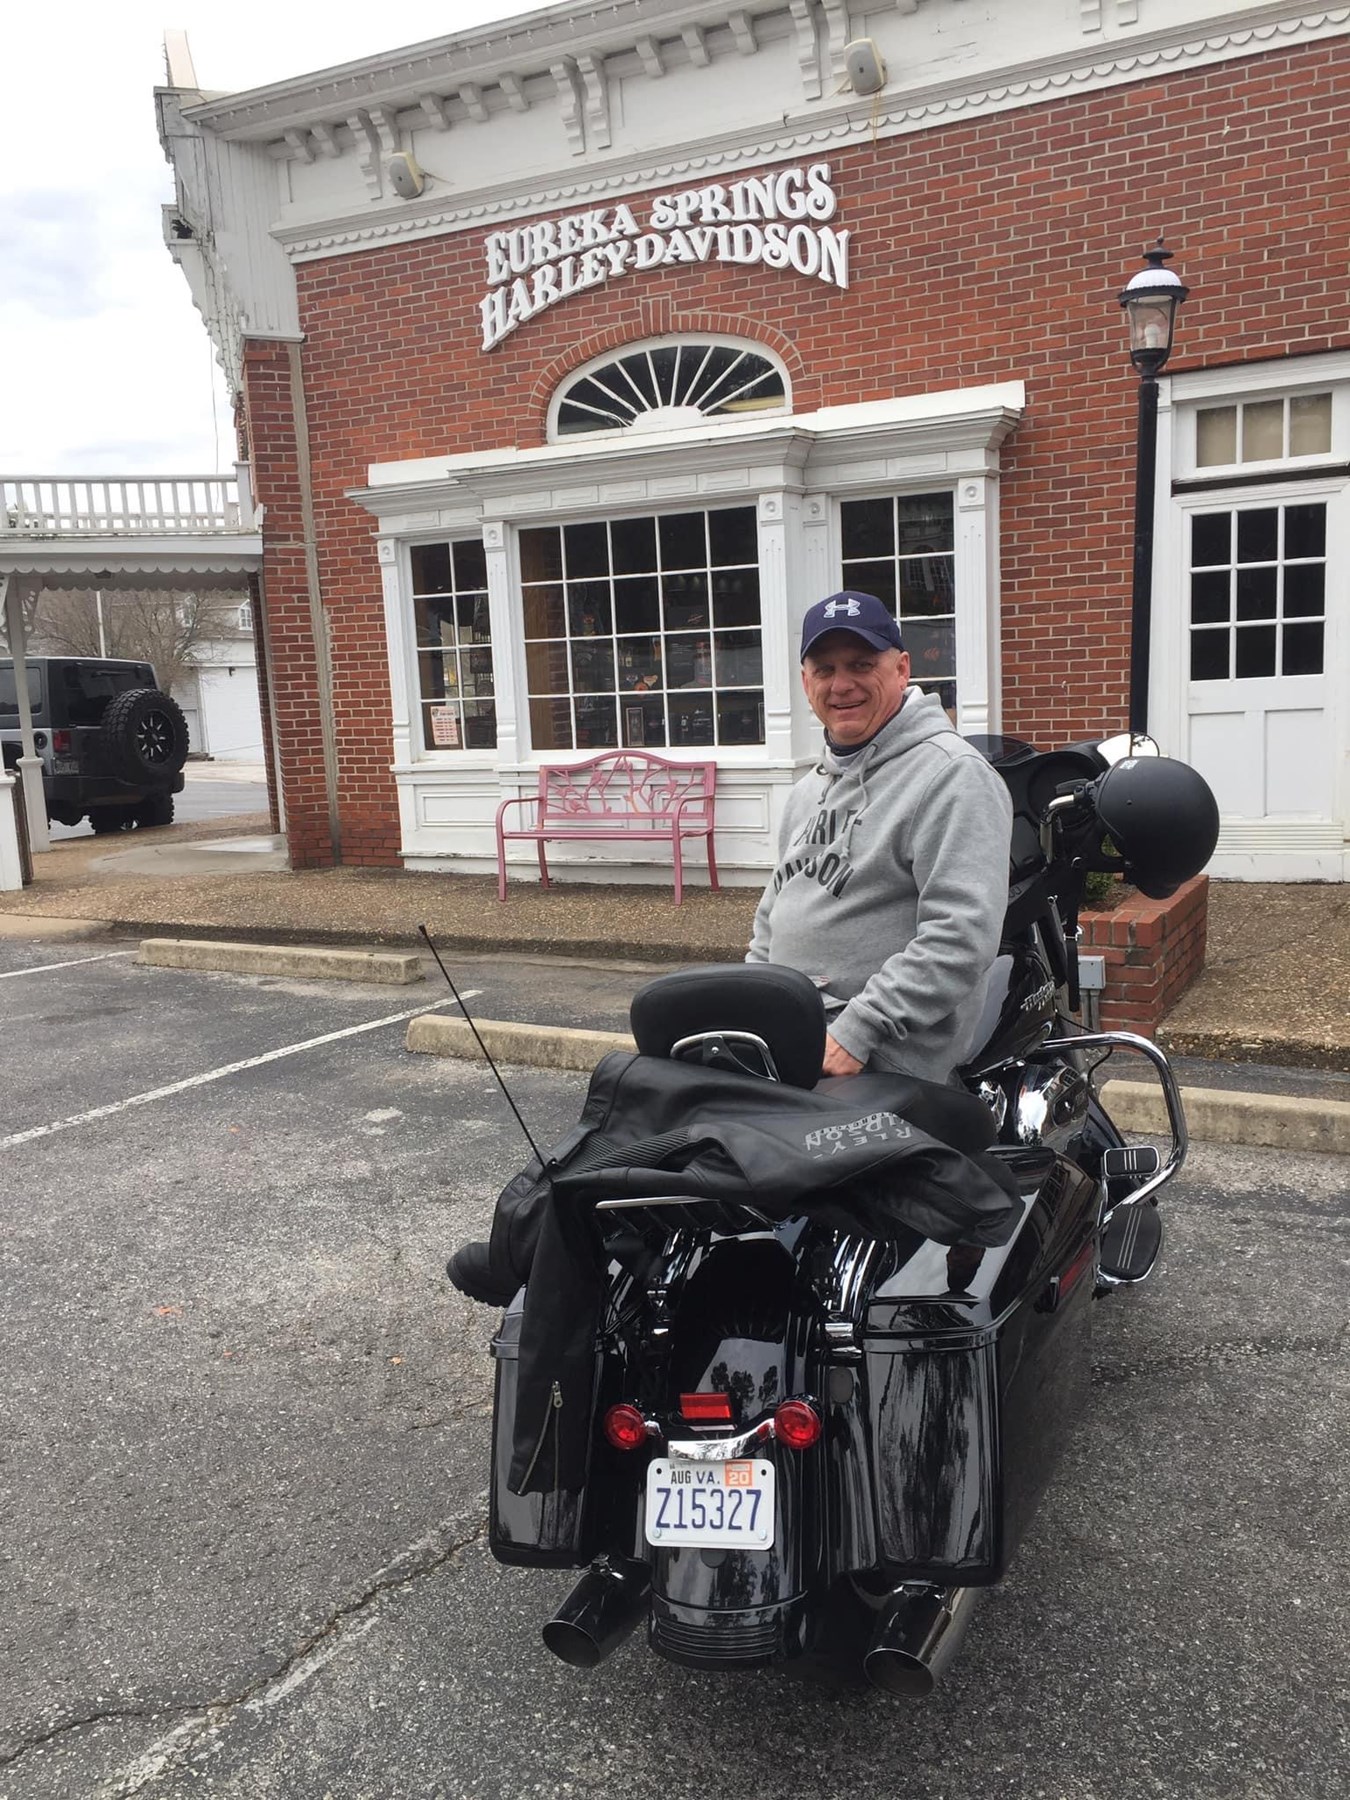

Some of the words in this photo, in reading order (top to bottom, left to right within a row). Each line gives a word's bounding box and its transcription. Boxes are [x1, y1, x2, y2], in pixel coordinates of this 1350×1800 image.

[484, 204, 641, 286] EUREKA
[650, 163, 838, 231] SPRINGS
[479, 223, 851, 352] HARLEY-DAVIDSON
[813, 1127, 912, 1159] RLEY-
[670, 1470, 691, 1485] AUG
[696, 1471, 720, 1485] VA.
[729, 1471, 750, 1485] 20
[655, 1487, 763, 1531] Z15327
